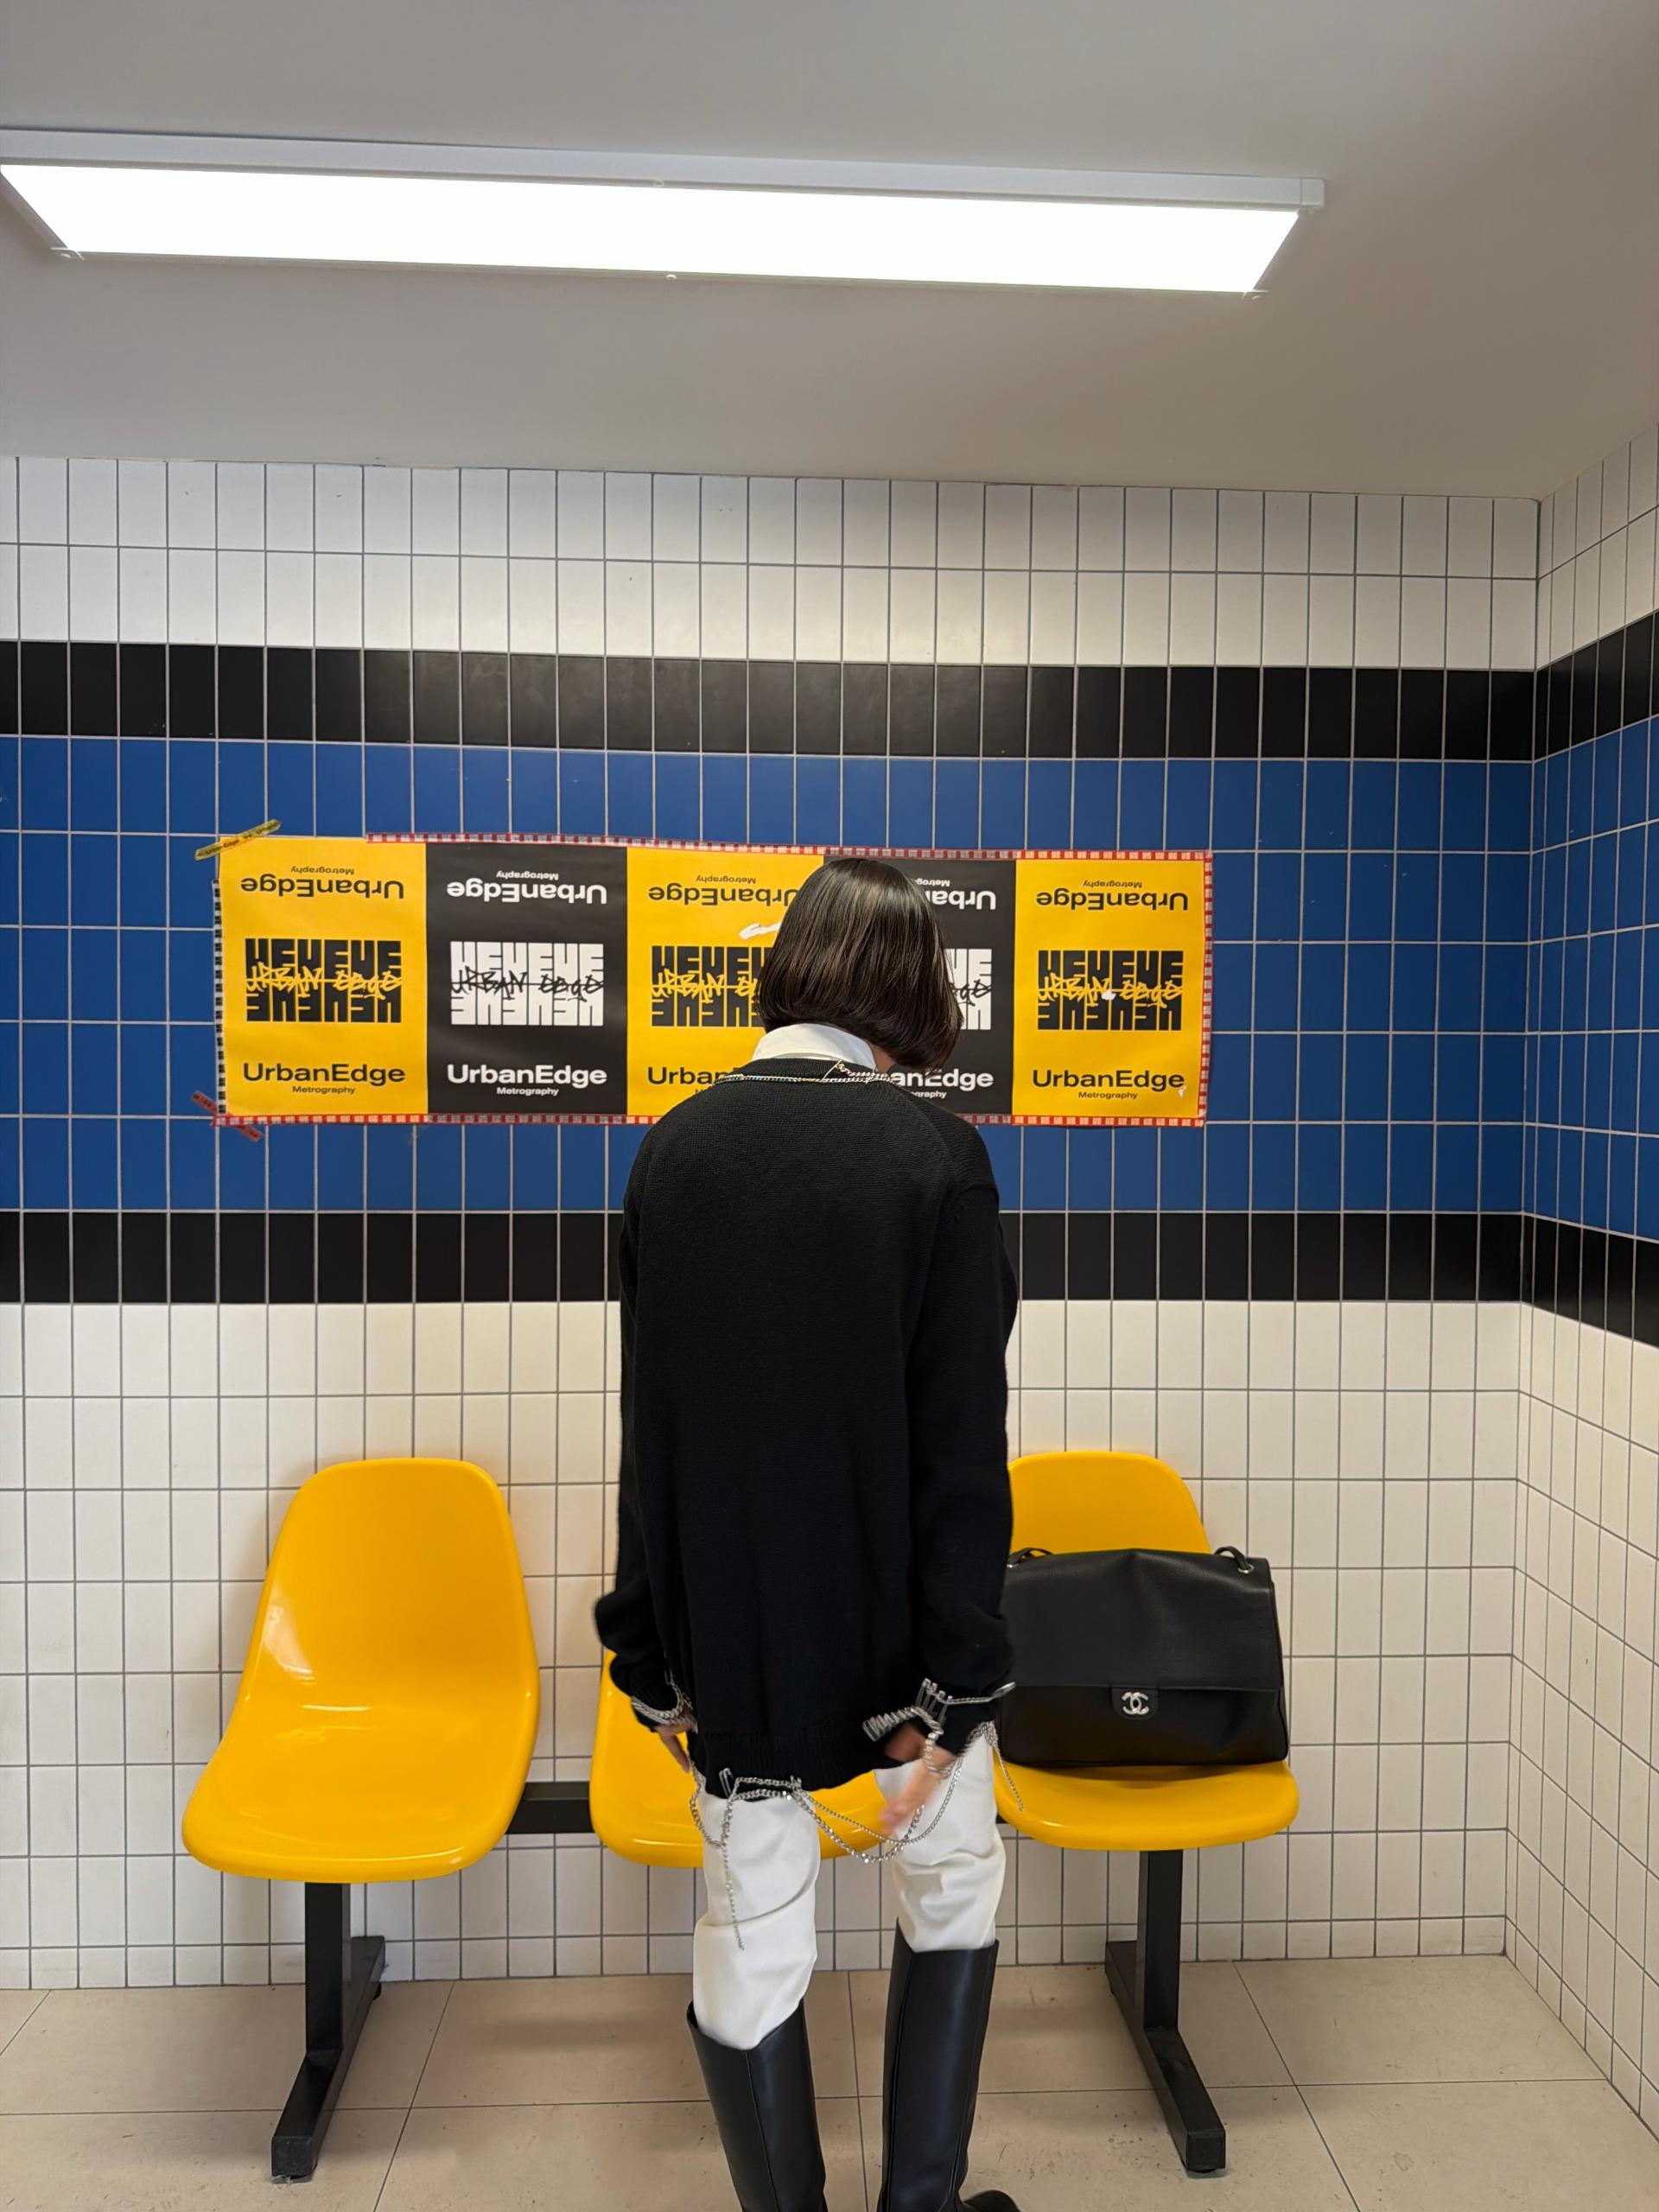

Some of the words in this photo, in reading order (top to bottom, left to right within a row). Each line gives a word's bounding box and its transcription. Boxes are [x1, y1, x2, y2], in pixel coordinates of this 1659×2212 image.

[291, 866, 354, 875] Metrography
[496, 870, 559, 880] Metrography
[240, 873, 404, 899] UrbanEdge
[696, 875, 756, 885] Metrography
[915, 877, 950, 887] Metrog
[1083, 880, 1142, 889] Metrography
[447, 880, 607, 905] UrbanEdge
[1036, 887, 1188, 912] UrbanEdge
[243, 1063, 405, 1086] UrbanEdge
[447, 1064, 607, 1087] UrbanEdge
[647, 1066, 731, 1084] Urban
[891, 1068, 995, 1091] anEdge
[1033, 1070, 1185, 1092] UrbanEdge
[292, 1085, 356, 1095] Metrography
[496, 1086, 560, 1096] Metrography
[1078, 1091, 1138, 1100] Metrography
